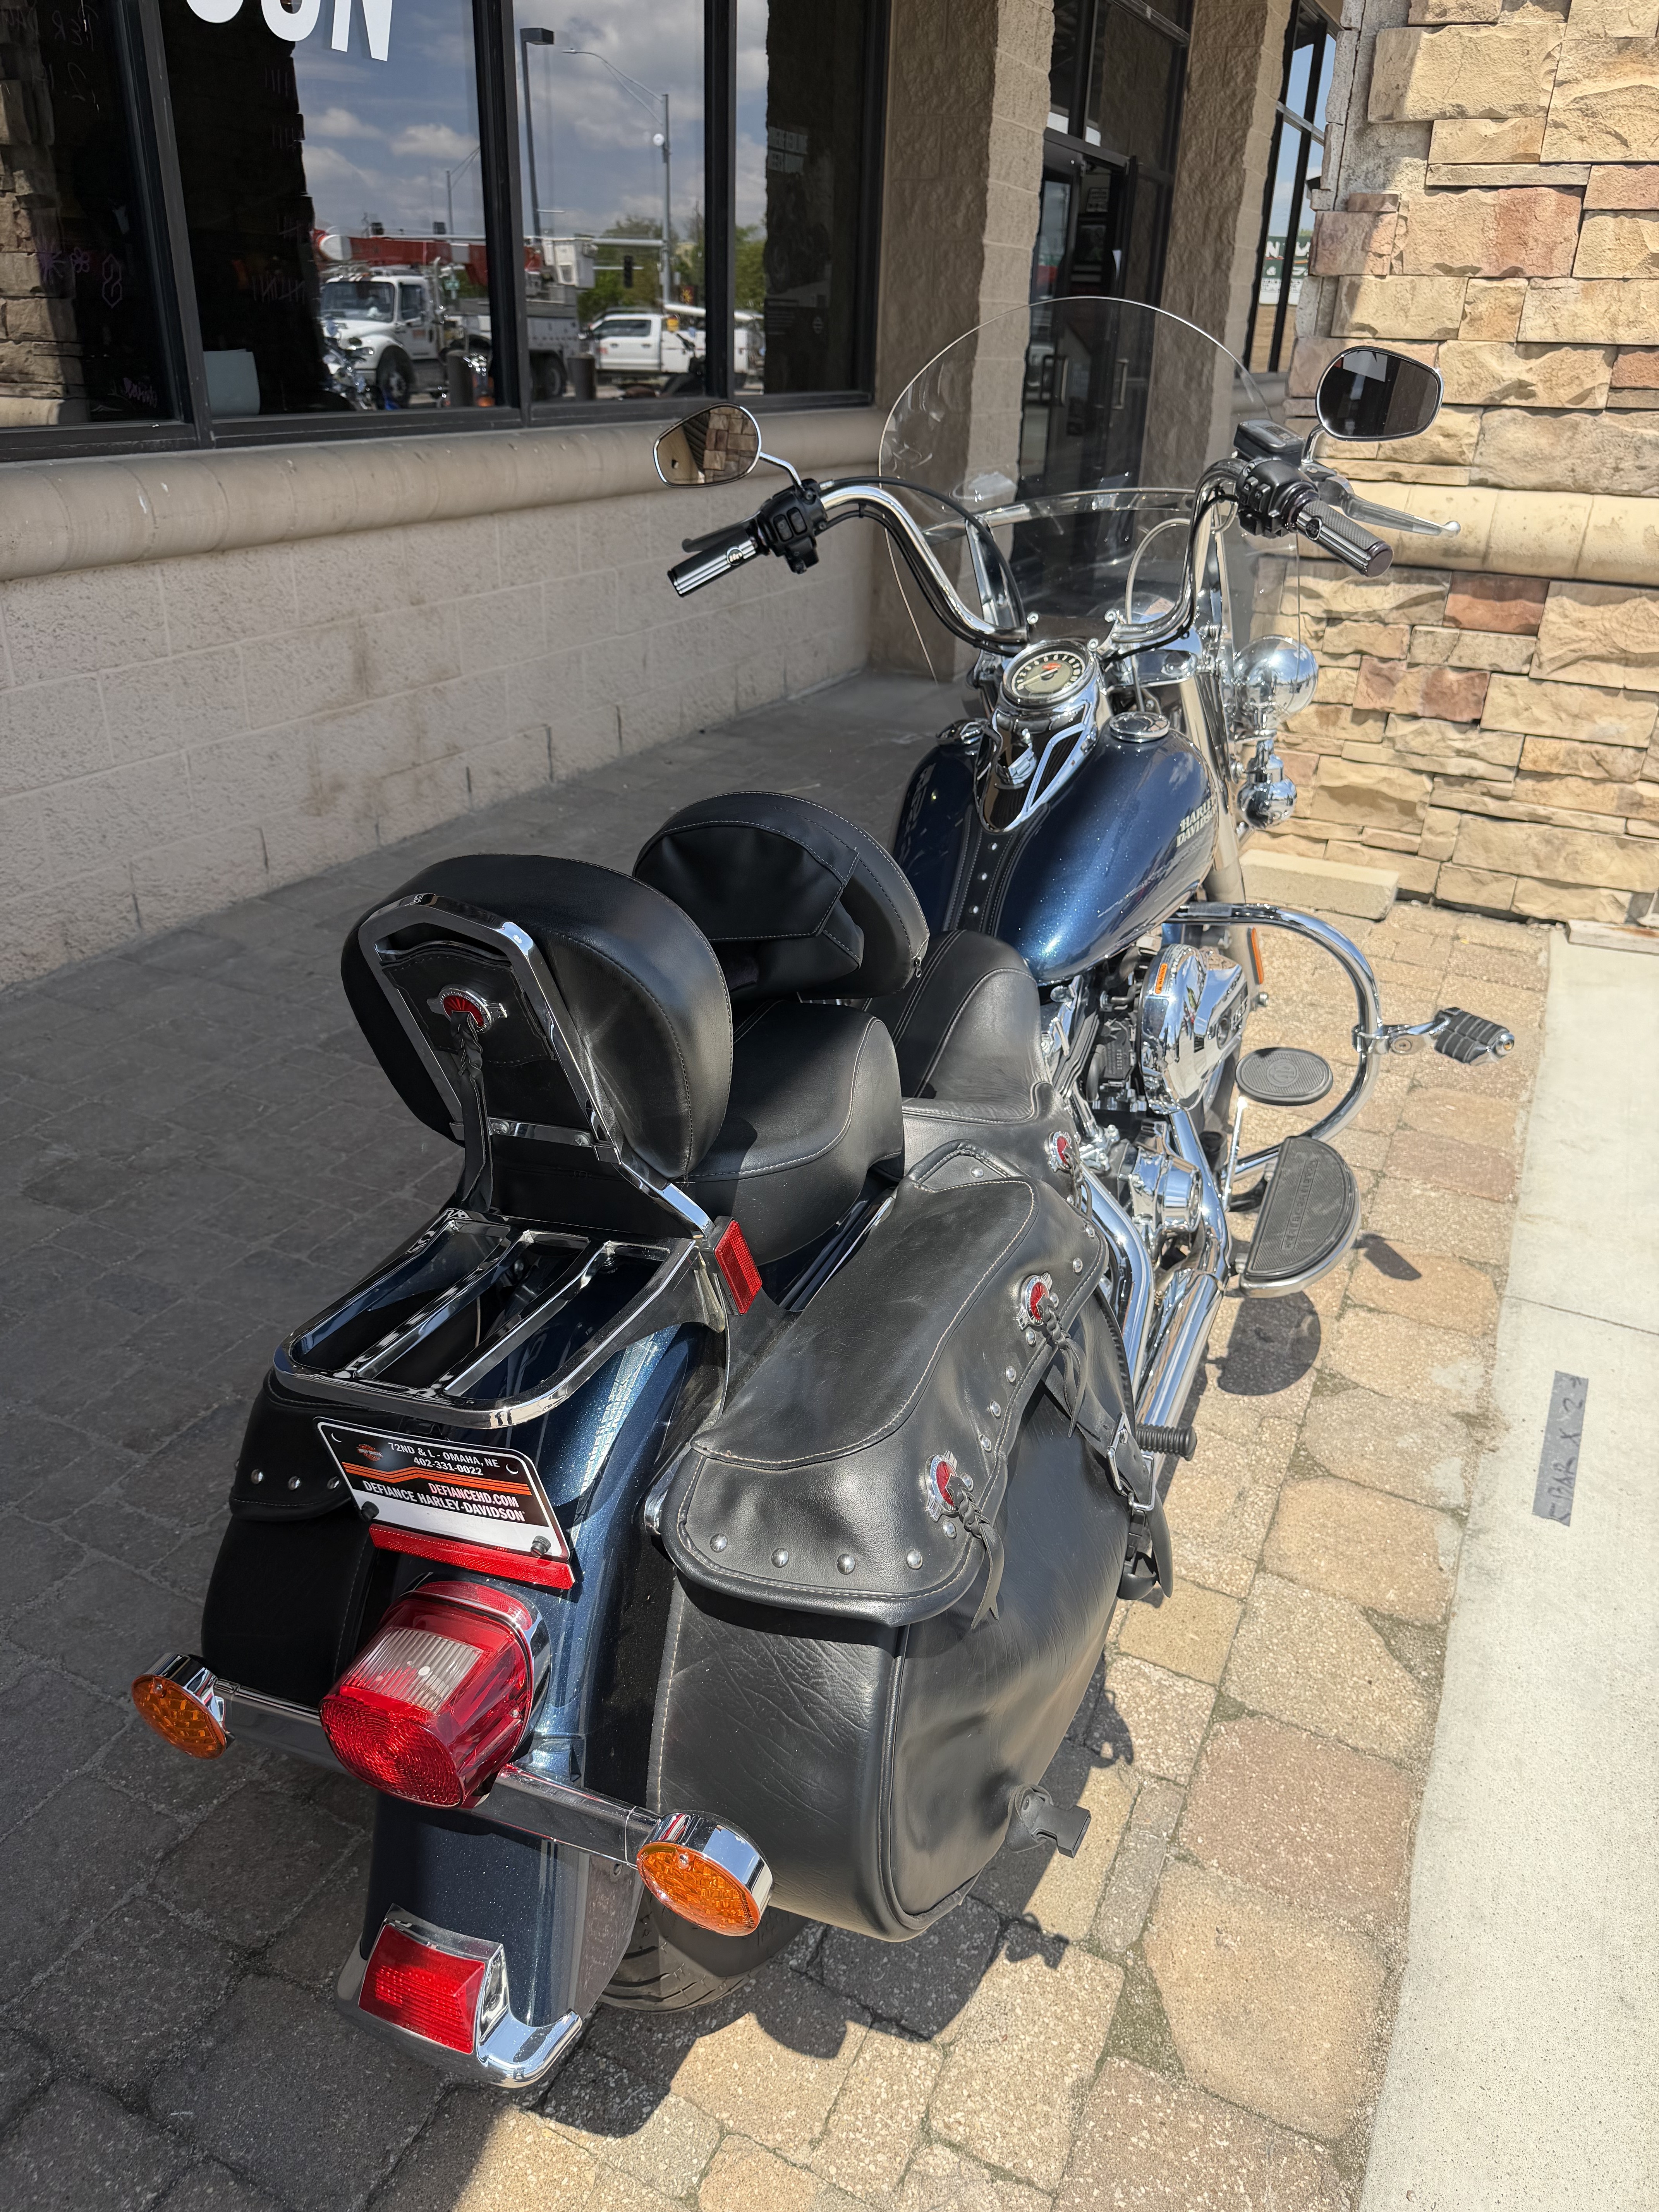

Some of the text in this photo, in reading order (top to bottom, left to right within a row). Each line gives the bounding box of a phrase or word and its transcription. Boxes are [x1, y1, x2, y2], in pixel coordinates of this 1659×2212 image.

[388, 1442, 415, 1454] 72ND
[417, 1448, 426, 1456] &
[428, 1449, 435, 1458] L
[443, 1452, 484, 1467] OMAHA,
[484, 1458, 500, 1467] NE
[414, 1457, 484, 1475] 402-331-0022
[362, 1480, 526, 1522] DEFIANCE HARLEY-DAVIDSON
[428, 1483, 519, 1507] DEFIANCEHD.COM
